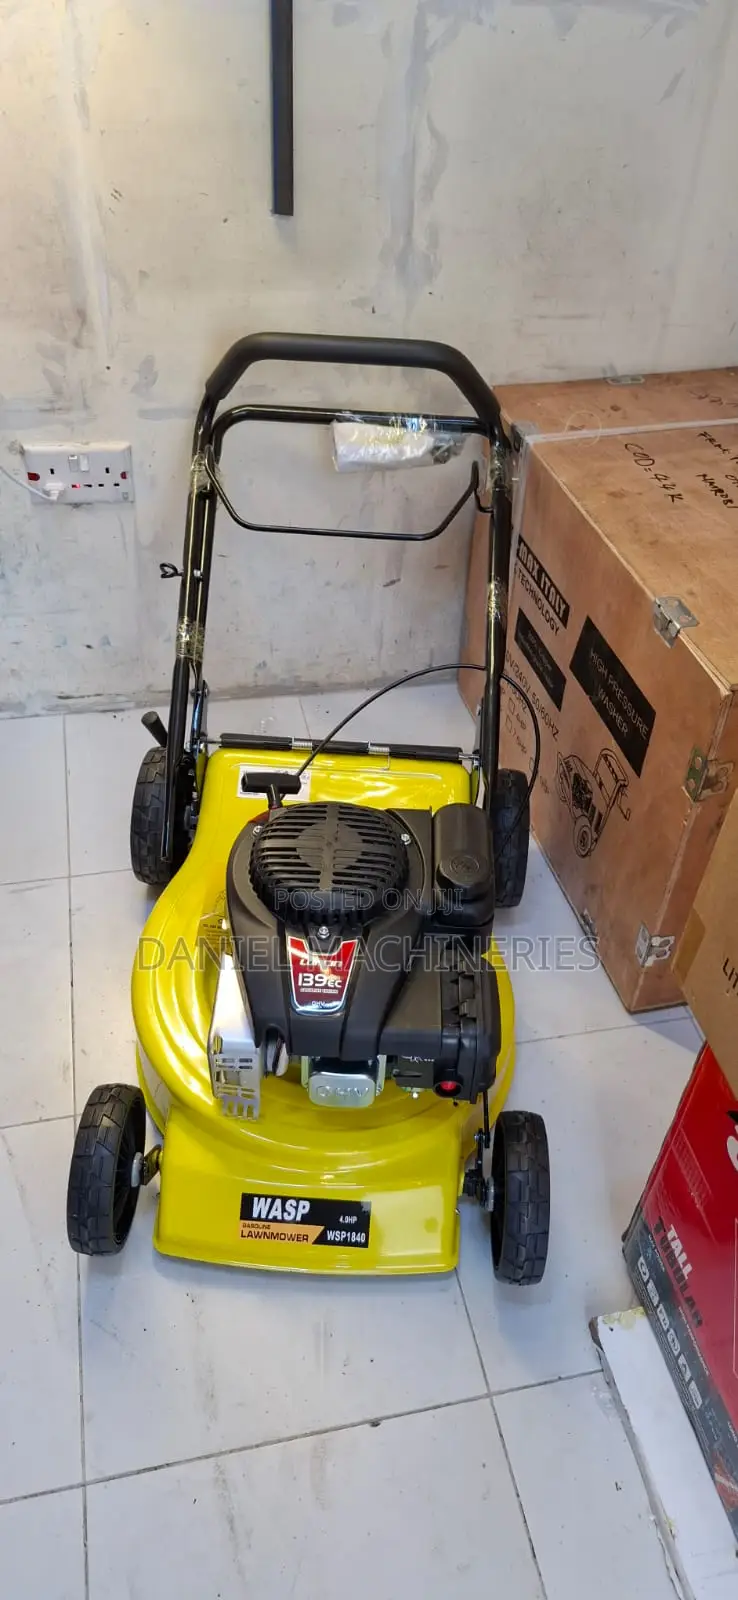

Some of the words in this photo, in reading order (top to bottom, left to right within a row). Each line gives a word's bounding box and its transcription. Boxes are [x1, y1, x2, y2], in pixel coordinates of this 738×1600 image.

[518, 567, 560, 636] TECHNOLOGY
[590, 647, 608, 678] HIGH
[607, 673, 649, 740] PRESSURE
[598, 684, 629, 738] WASHER
[251, 1196, 311, 1221] WASP
[339, 1215, 358, 1224] 4.0HP
[240, 1229, 309, 1243] LAWNMOWER
[326, 1229, 366, 1243] WSP1840
